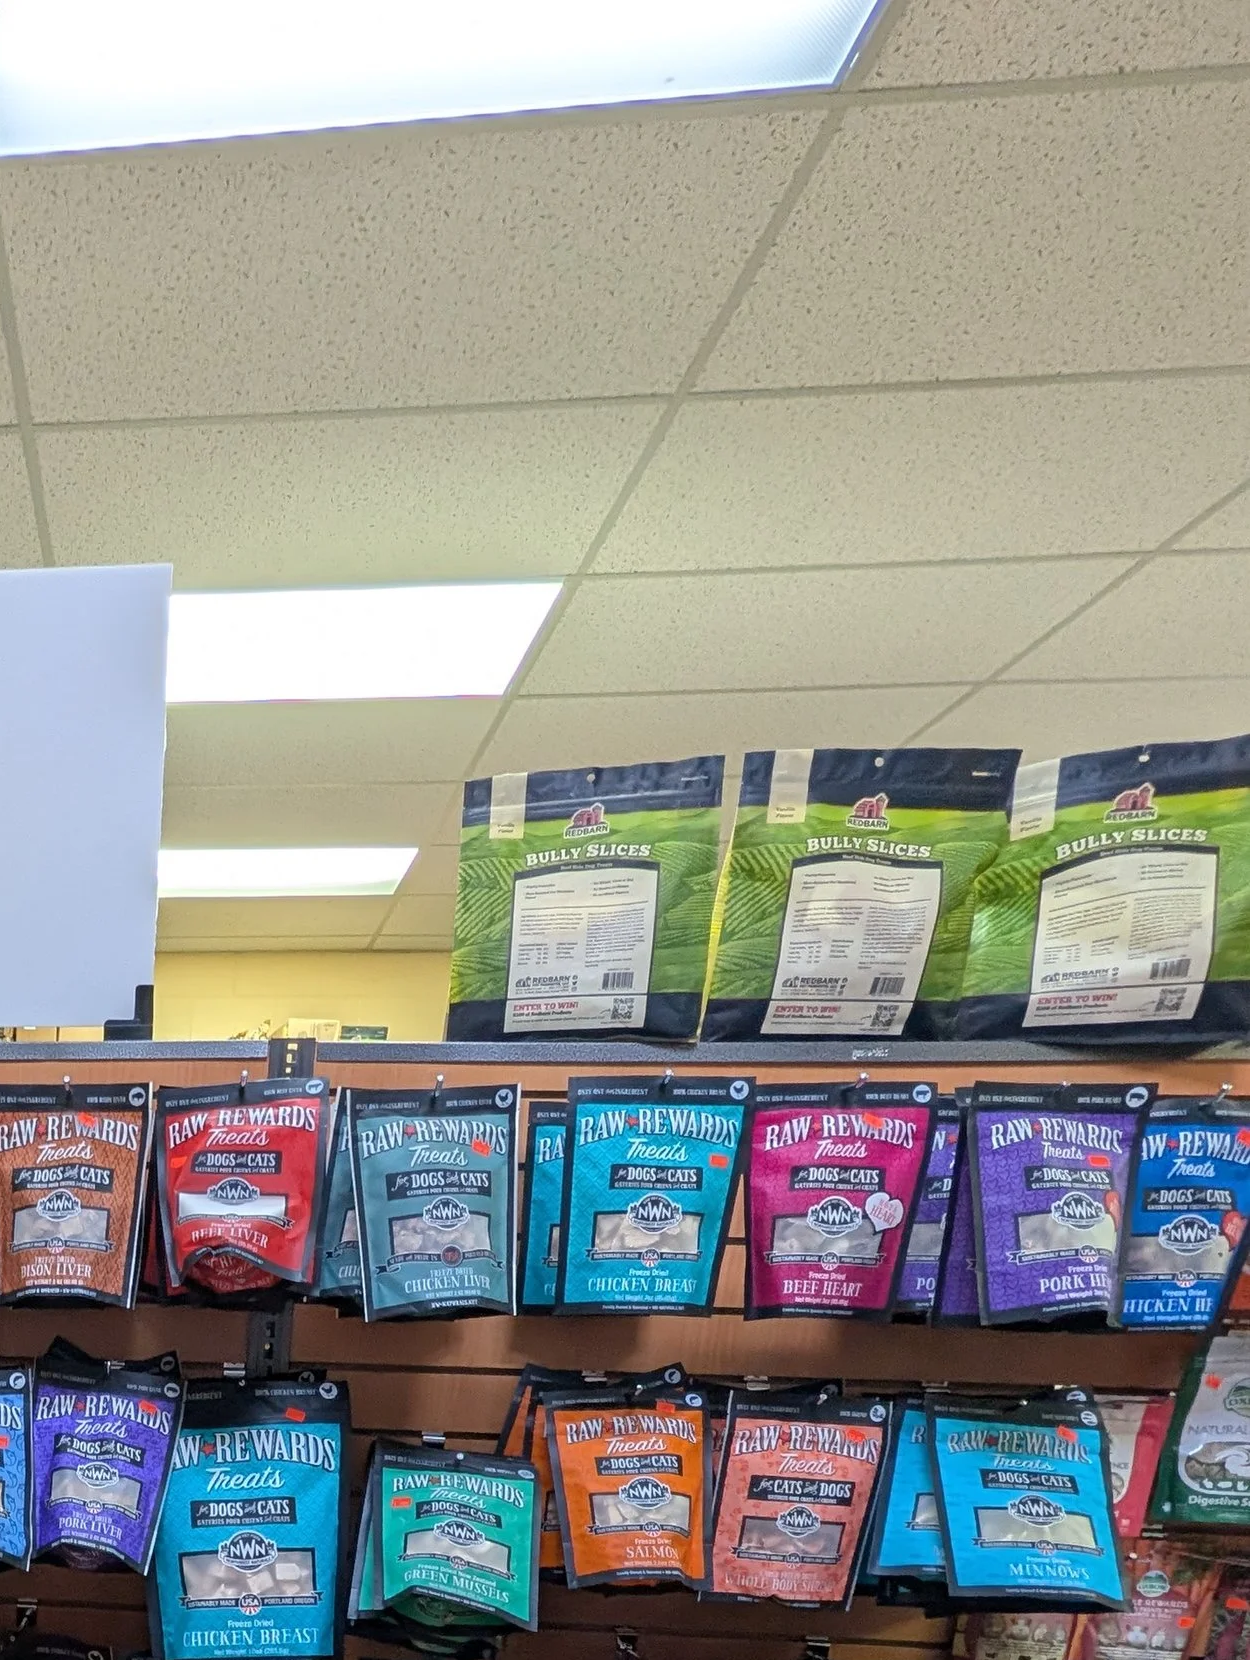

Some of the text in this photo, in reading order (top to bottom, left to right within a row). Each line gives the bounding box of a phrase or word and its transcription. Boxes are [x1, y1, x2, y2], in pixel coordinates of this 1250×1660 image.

[847, 818, 888, 828] REDBARN
[1105, 810, 1156, 822] REDBARN
[565, 825, 608, 837] REDBARN
[807, 837, 931, 857] BULLY SLICES
[1055, 828, 1208, 859] BULLY SLICES
[526, 844, 651, 866] BULLY SLICES
[513, 1003, 541, 1011] ENTER
[168, 1106, 317, 1149] RAW REWARDS
[206, 1127, 269, 1148] Treats
[578, 1108, 741, 1149] RAW REWARDS
[990, 1117, 1123, 1155] RAW REWARDS
[361, 1118, 508, 1159] RAW REWARDS
[36, 1142, 94, 1164] Treats
[409, 1145, 469, 1168] Treats
[627, 1138, 689, 1161] Treats
[626, 1168, 698, 1182] DOGS CATS
[638, 1206, 671, 1220] NWN
[190, 1228, 269, 1249] BEEF LIVER
[20, 1262, 92, 1280] BISON LIVER
[404, 1274, 491, 1294] CHICKEN LIVER
[588, 1276, 698, 1292] CHICKEN BREAST
[782, 1279, 864, 1298] BEEF HEART
[1039, 1275, 1084, 1295] PORK
[565, 1415, 697, 1443] RAW REWARDS
[1188, 1424, 1247, 1436] NATURAL
[947, 1429, 1093, 1465] RAW REWARDS
[392, 1474, 525, 1509] RAW REWARDS
[772, 1480, 852, 1499] CATS DOGS
[209, 1502, 244, 1516] DOGS
[257, 1500, 291, 1515] CATS
[1188, 1494, 1238, 1507] Digestive
[58, 1516, 124, 1540] PORK LIVER
[229, 1541, 267, 1557] NWN
[626, 1545, 680, 1559] SALMON
[1008, 1563, 1091, 1581] MINNOWS
[403, 1569, 510, 1603] GREEN MUSSELS
[254, 1619, 274, 1627] Dried
[183, 1628, 319, 1647] CHICKEN BREAST
